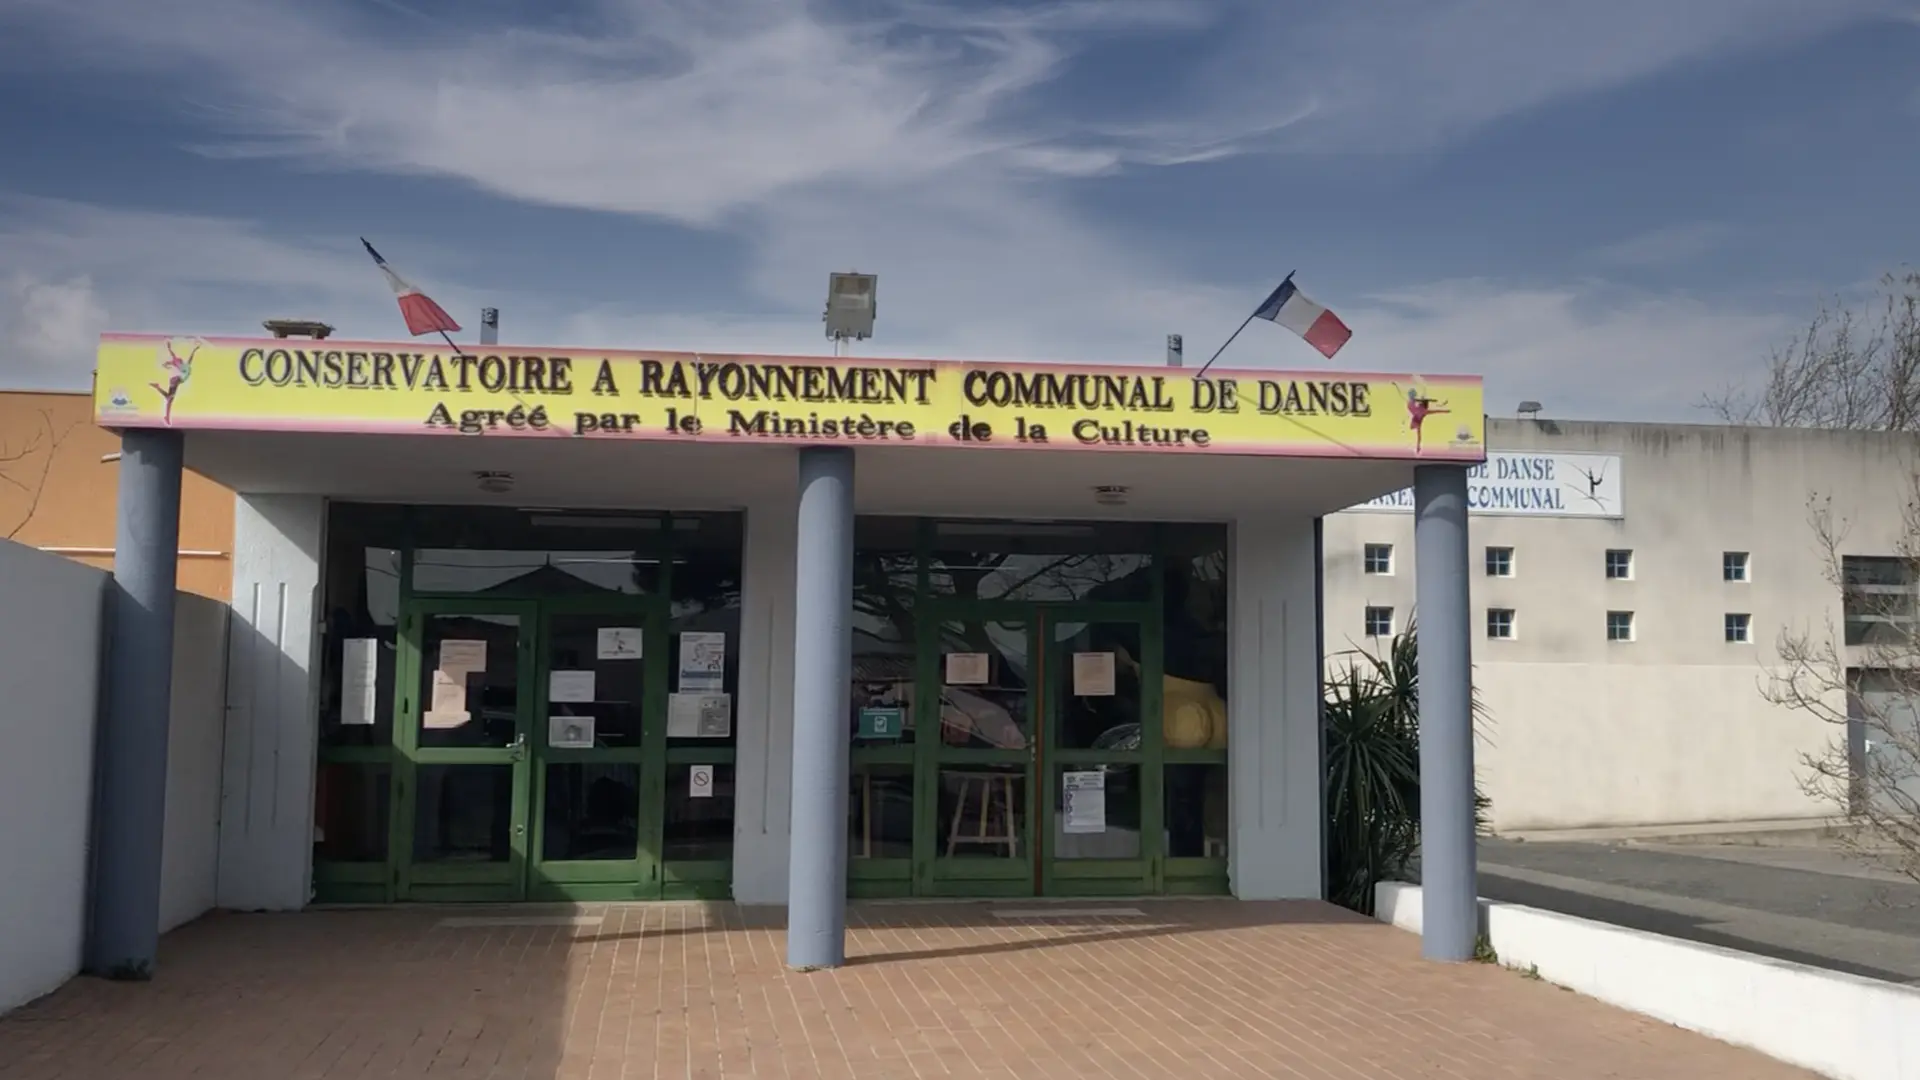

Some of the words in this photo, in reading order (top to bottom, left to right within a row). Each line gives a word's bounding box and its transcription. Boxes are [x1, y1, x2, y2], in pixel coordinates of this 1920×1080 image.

[239, 347, 573, 396] CONSERVATOIRE
[592, 358, 620, 397] A
[638, 360, 937, 406] RAYONNEMENT
[963, 369, 1174, 412] COMMUNAL
[1190, 377, 1240, 414] DE
[1257, 379, 1372, 417] DANSE
[423, 401, 549, 436] Agréé
[573, 411, 641, 436] par
[664, 407, 703, 434] le
[726, 410, 916, 441] Ministère
[948, 414, 993, 442] de
[1013, 416, 1049, 443] la
[1072, 418, 1212, 447] Culture
[1467, 460, 1489, 479] DE
[1497, 457, 1555, 481] DANSE
[1466, 485, 1565, 509] COMMUNAL
